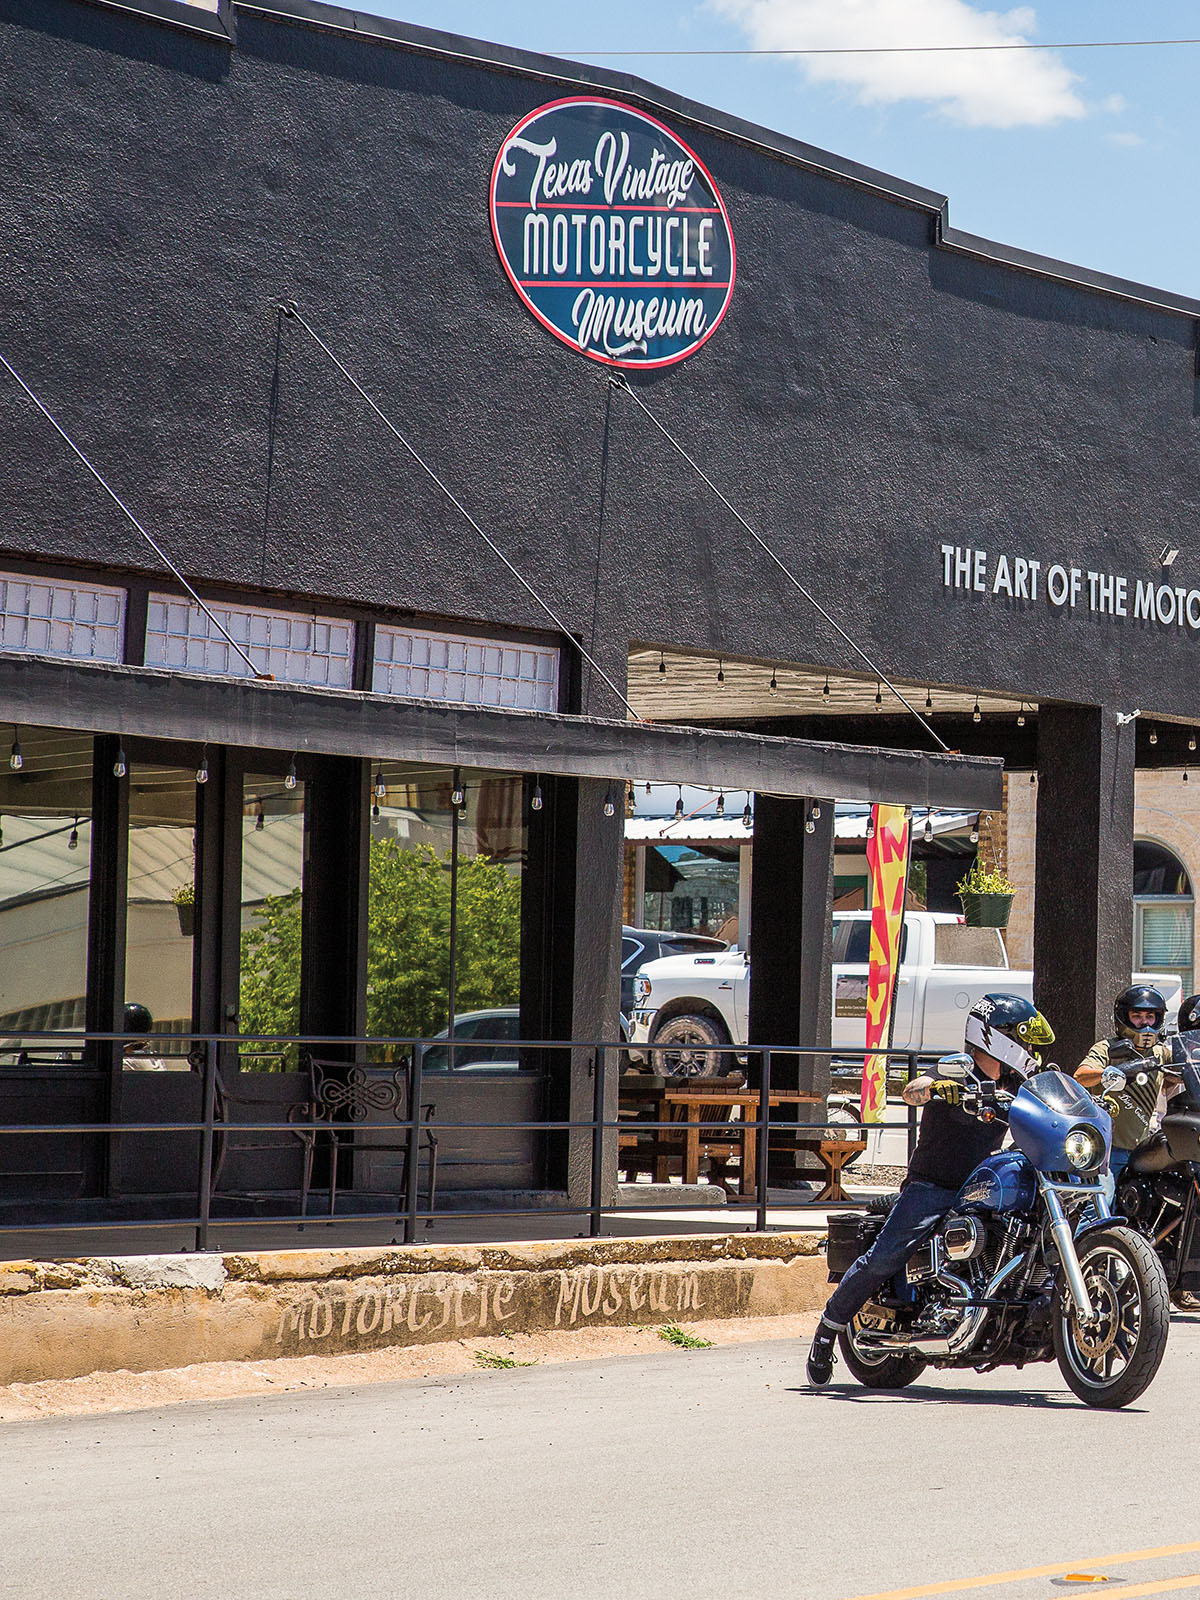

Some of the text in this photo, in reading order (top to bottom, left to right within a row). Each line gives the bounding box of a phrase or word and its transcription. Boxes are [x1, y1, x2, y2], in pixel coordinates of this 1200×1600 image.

[502, 131, 695, 210] Texas Vintage
[523, 213, 713, 276] MOTORCYCLE
[572, 288, 707, 355] Museum
[942, 545, 986, 592] THE
[993, 555, 1040, 600] ART
[1048, 564, 1081, 607] OF
[1088, 571, 1127, 616] THE
